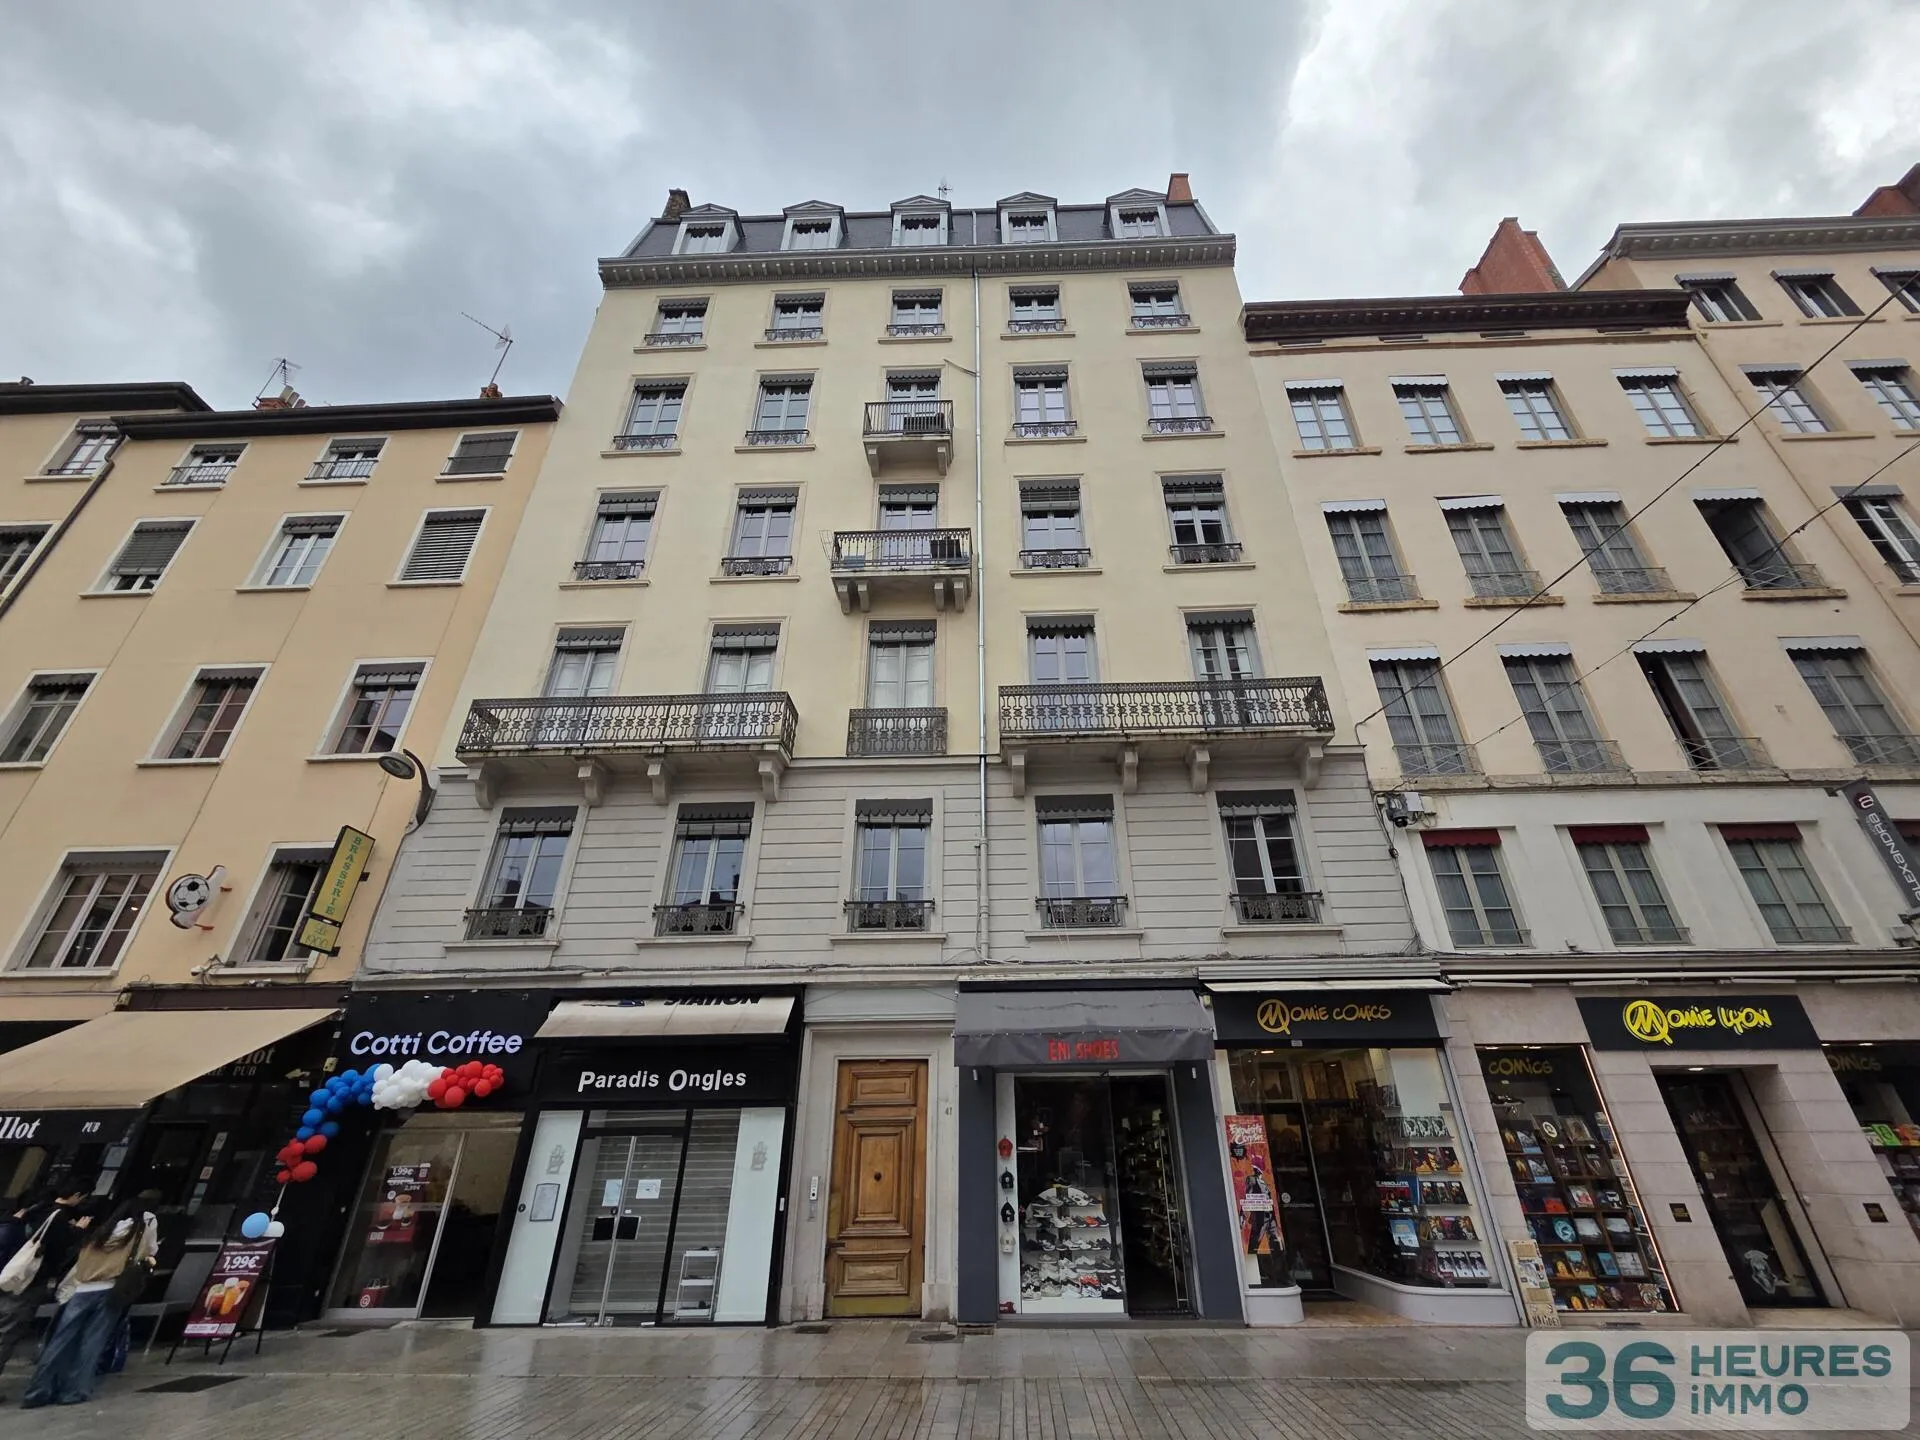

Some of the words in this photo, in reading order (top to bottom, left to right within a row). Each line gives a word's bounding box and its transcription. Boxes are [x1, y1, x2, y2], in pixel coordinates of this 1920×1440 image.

[325, 836, 363, 915] BRASSERIE
[350, 1031, 422, 1055] Cotti
[427, 1030, 523, 1055] Coffee
[1048, 1040, 1071, 1060] ENI
[1075, 1040, 1119, 1060] SHOES
[578, 1070, 660, 1093] Paradis
[668, 1069, 747, 1091] Ongles
[0, 1116, 41, 1139] llot
[81, 1121, 101, 1133] PUB
[223, 1255, 260, 1272] 1,99€
